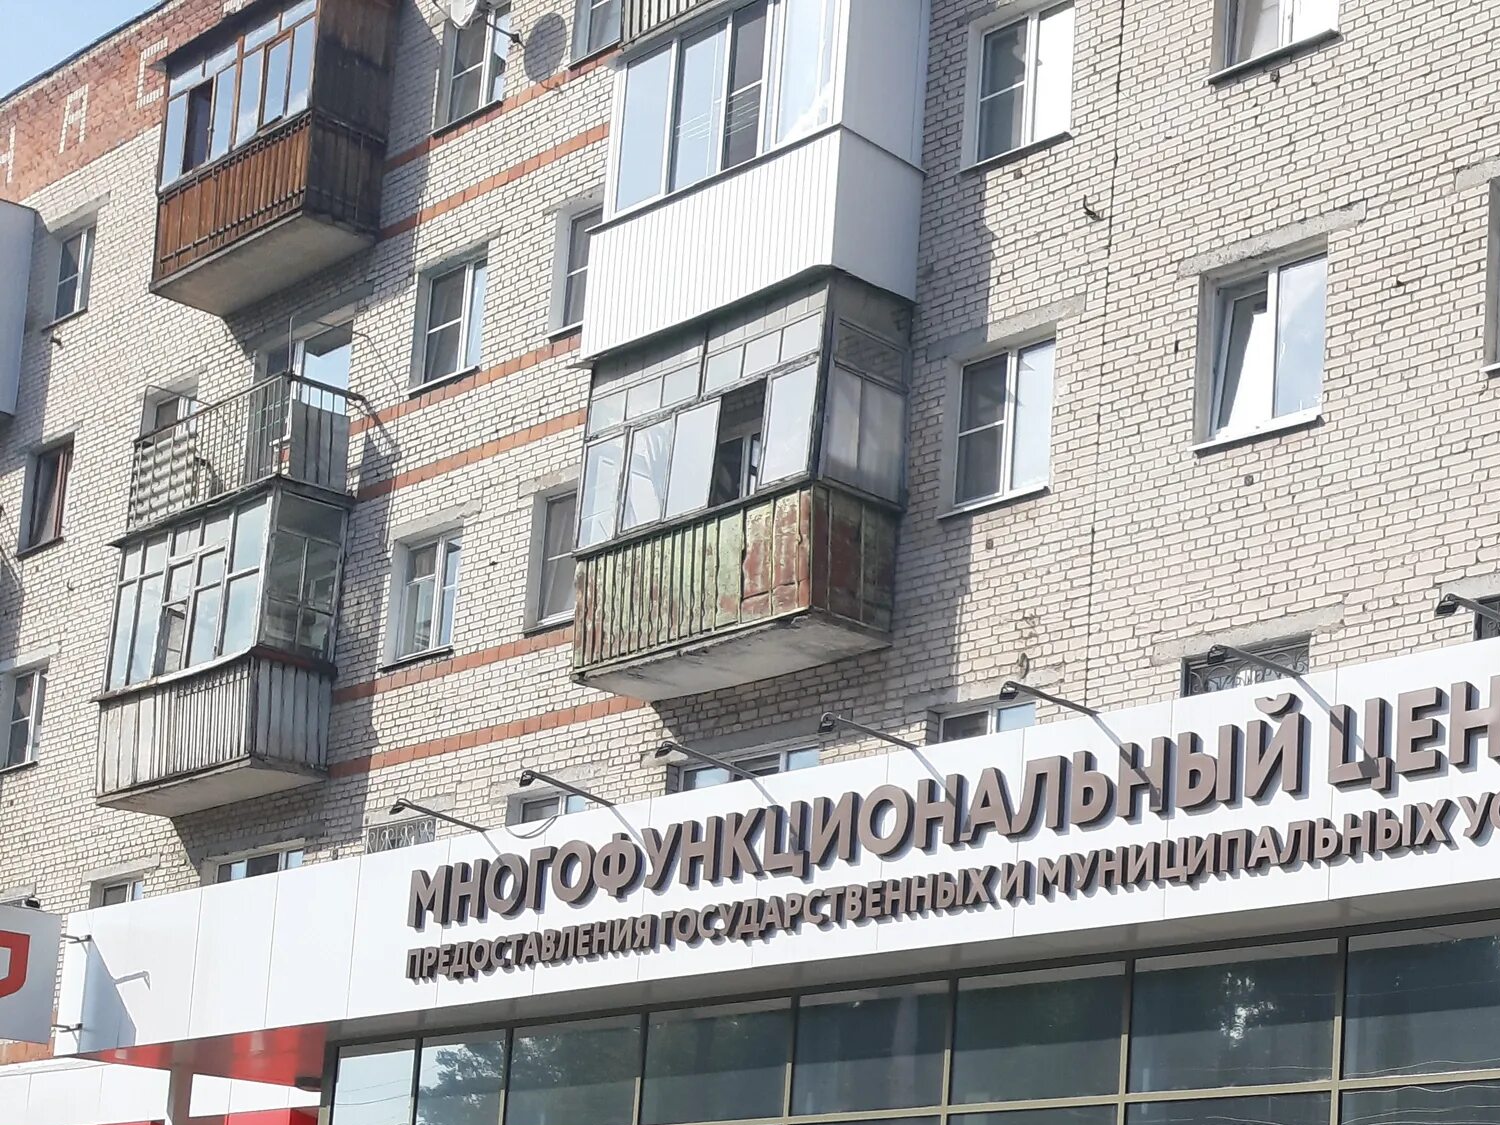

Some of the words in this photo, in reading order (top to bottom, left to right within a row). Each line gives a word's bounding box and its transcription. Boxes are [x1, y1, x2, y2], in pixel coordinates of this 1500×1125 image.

[406, 914, 656, 982] ПРЕДОСТАВЛЕНИЯ
[660, 864, 1001, 945] ГОСУДАРСТВЕННЫХ
[998, 860, 1030, 904] И
[1034, 802, 1458, 897] МУНИЦИПАЛЬНЫХ
[407, 693, 1311, 929] МНОГОФУНКЦИОНАЛЬНЫЙ
